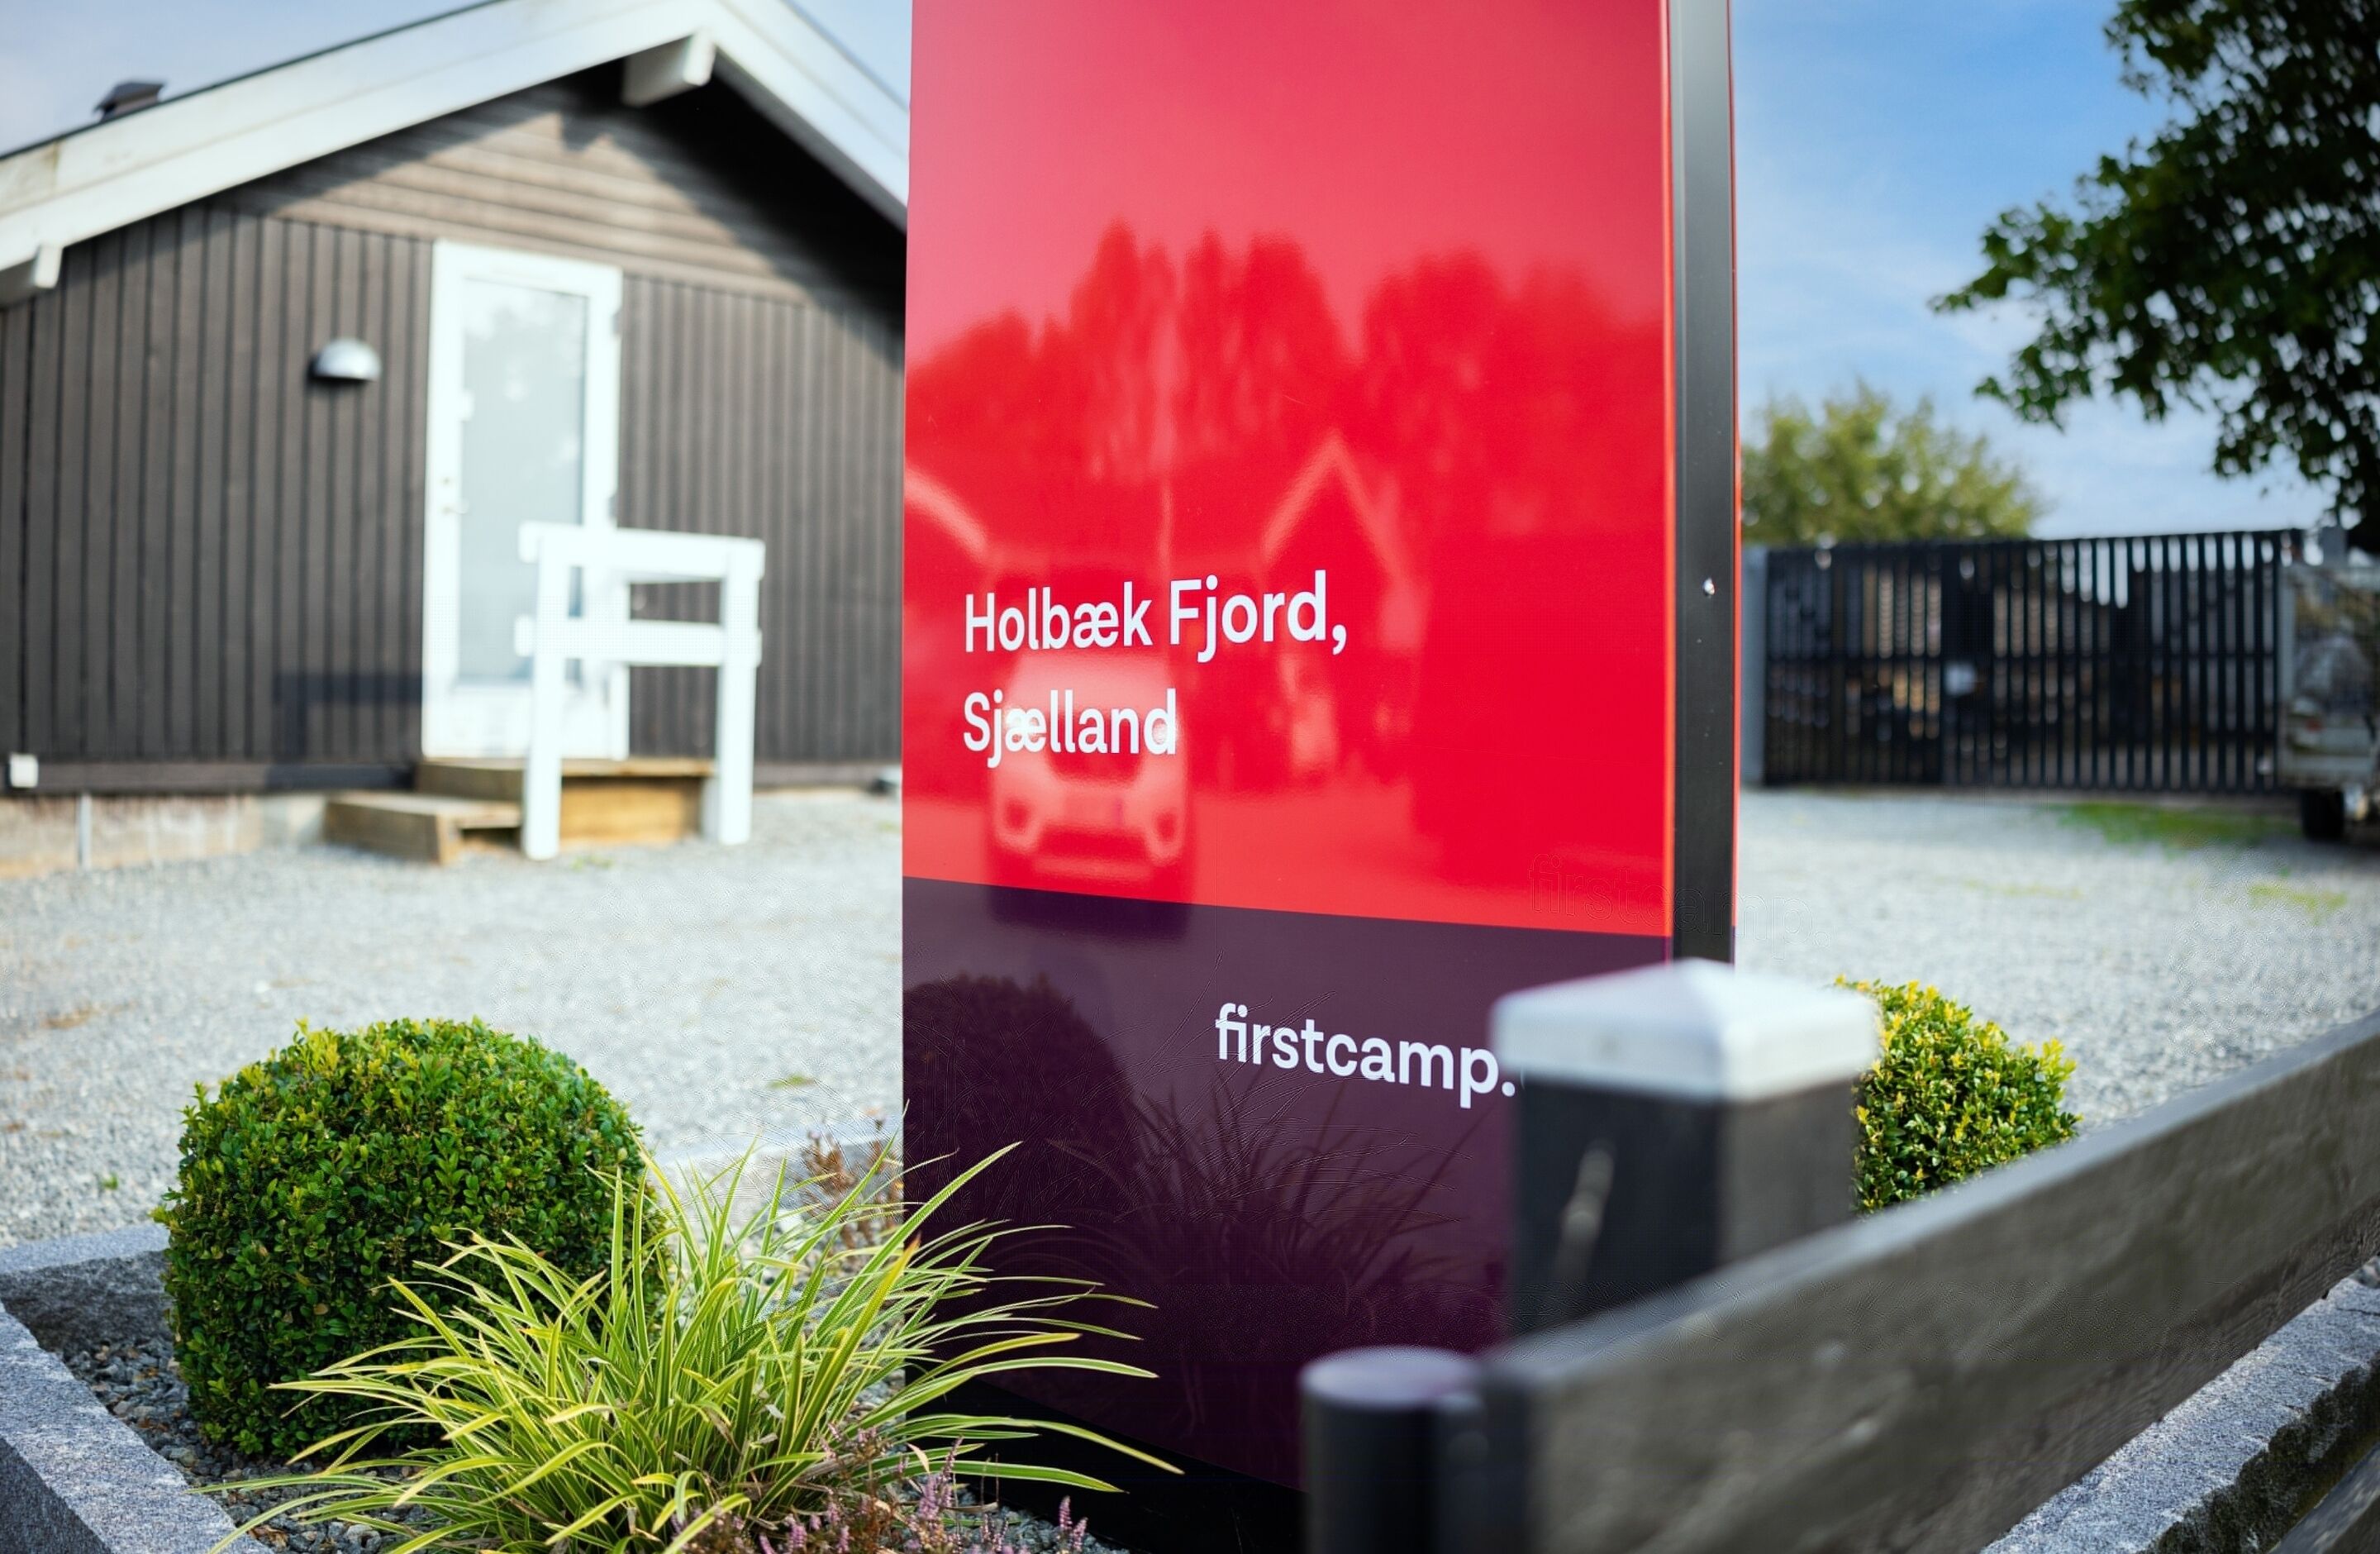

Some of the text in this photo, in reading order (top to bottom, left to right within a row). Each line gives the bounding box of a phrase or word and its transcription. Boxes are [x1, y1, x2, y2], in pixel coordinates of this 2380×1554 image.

[965, 570, 1347, 663] Holbæk Fjord,
[964, 688, 1178, 768] Sjælland
[1215, 1003, 1526, 1108] firstcamp.
